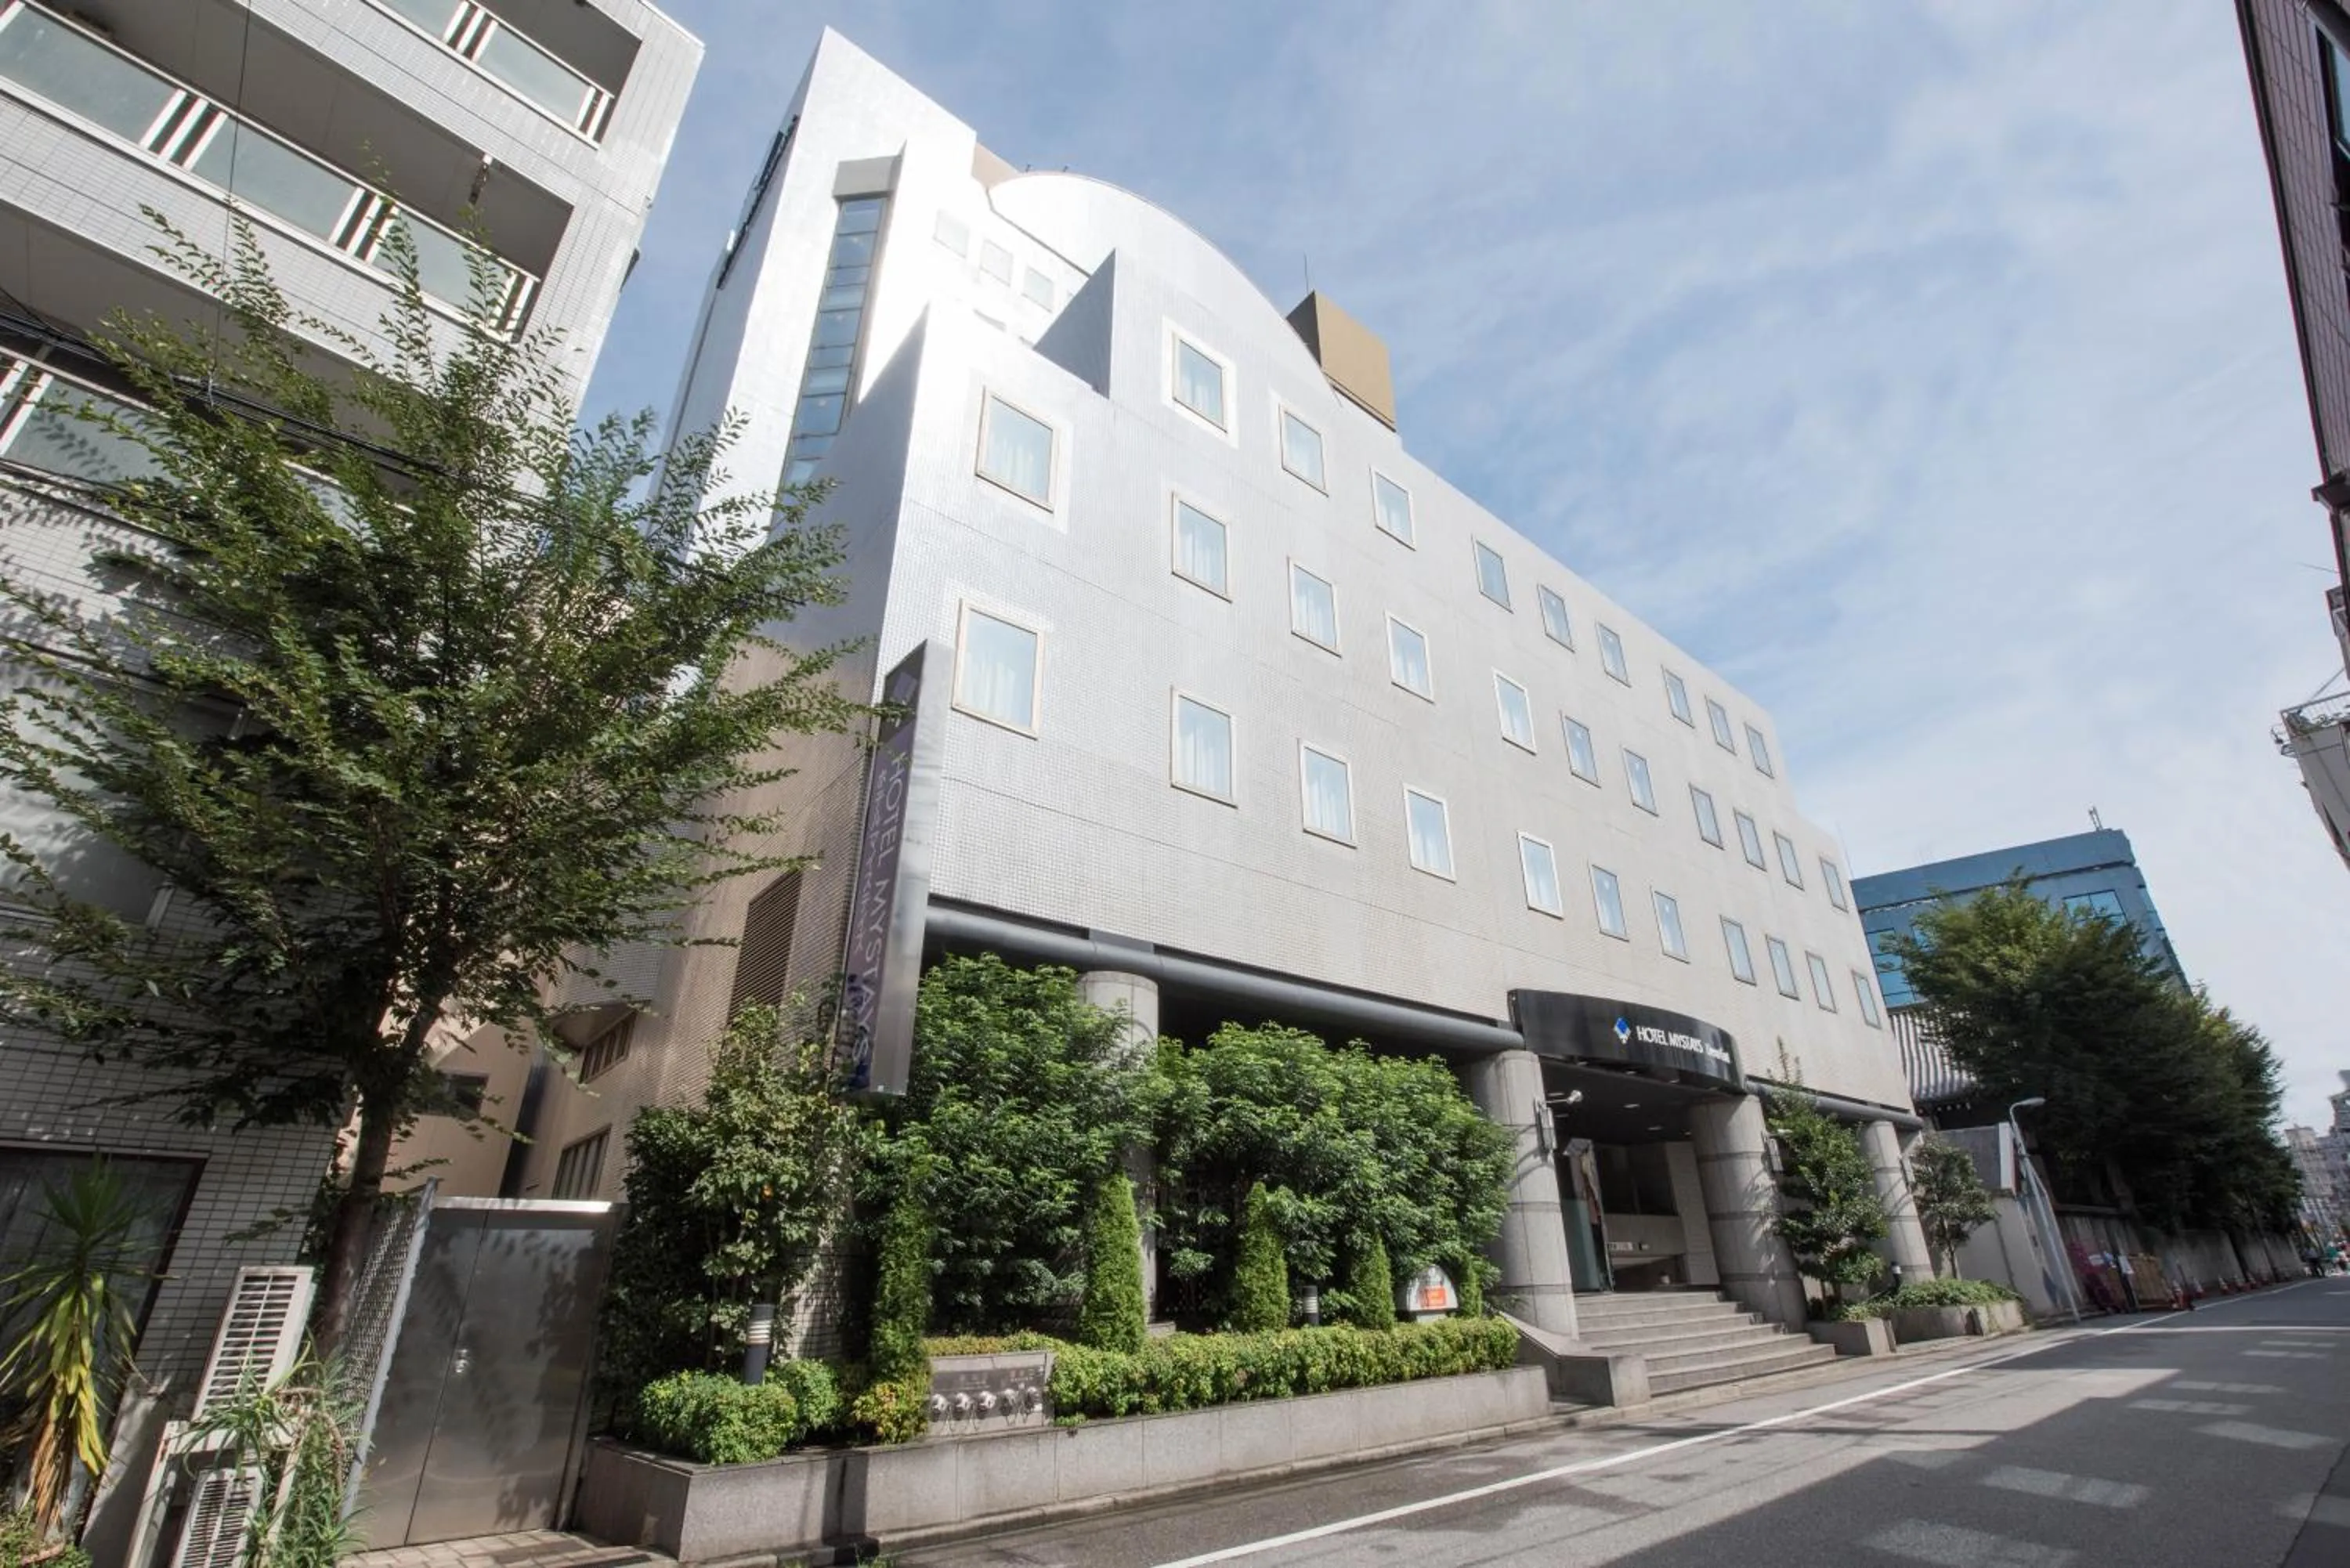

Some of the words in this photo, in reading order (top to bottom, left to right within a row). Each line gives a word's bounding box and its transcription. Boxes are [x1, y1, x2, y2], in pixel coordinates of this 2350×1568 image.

[877, 751, 906, 866] HOTEL
[853, 879, 890, 1064] MYSTAYS
[1636, 1026, 1668, 1045] HOTEL
